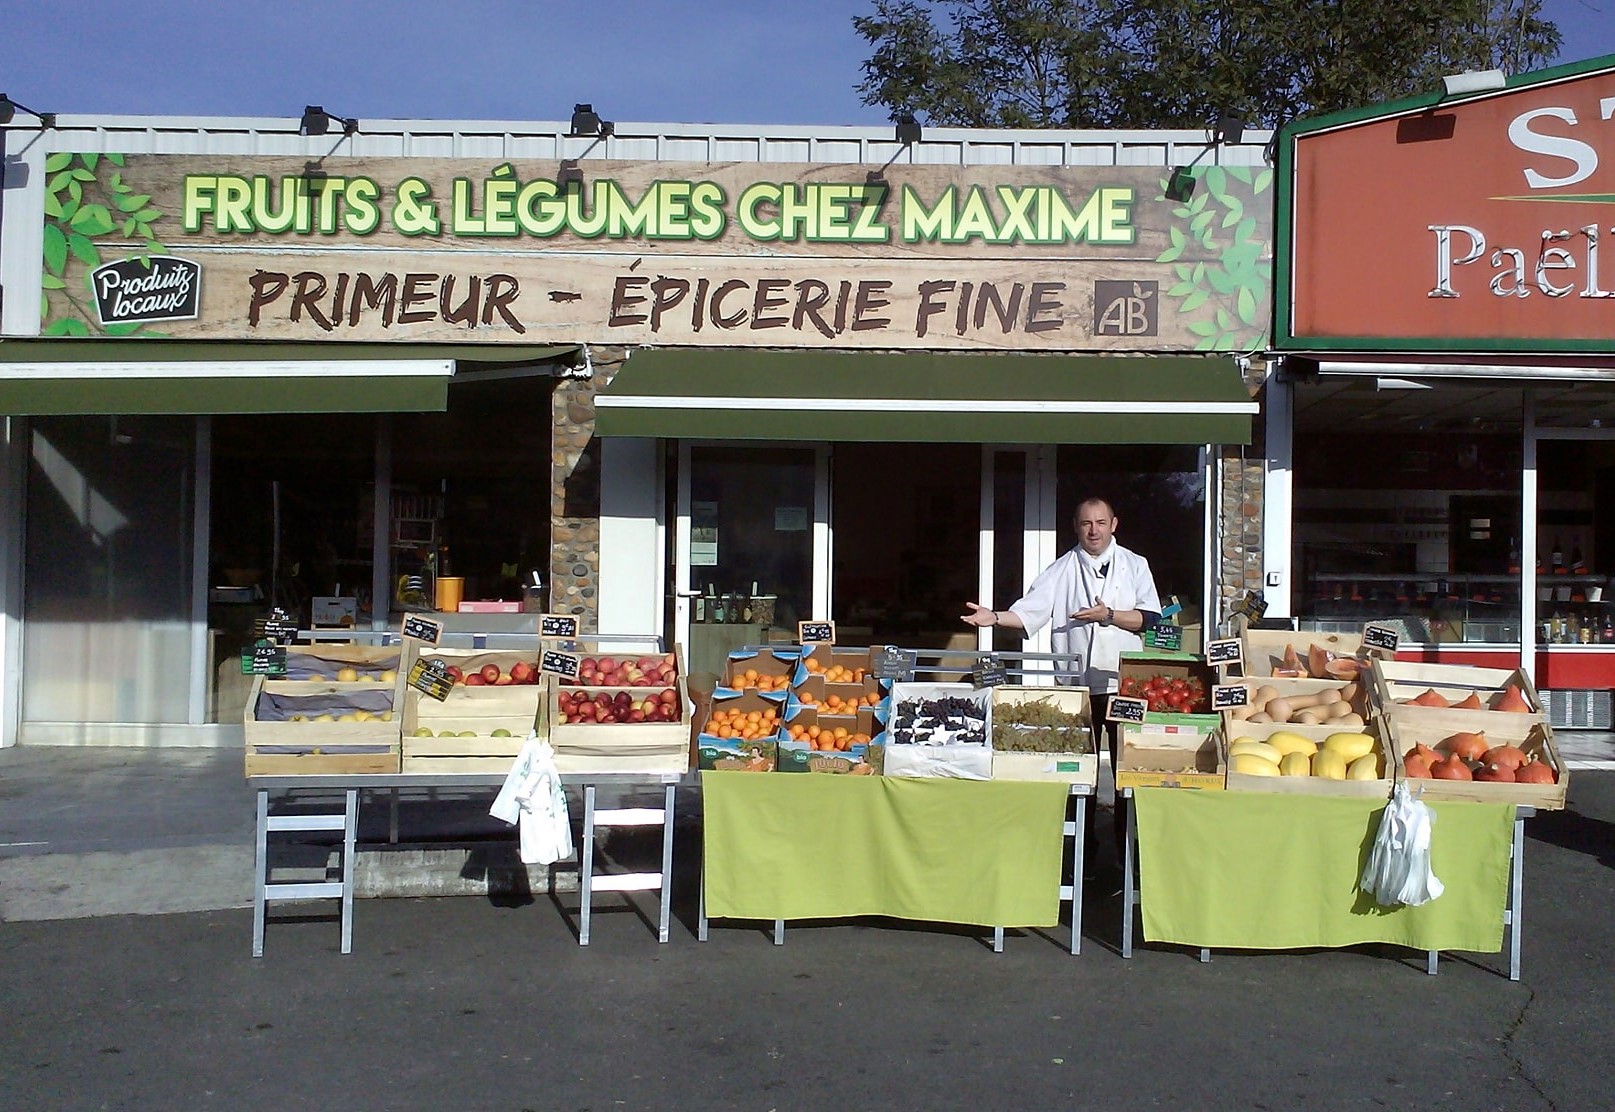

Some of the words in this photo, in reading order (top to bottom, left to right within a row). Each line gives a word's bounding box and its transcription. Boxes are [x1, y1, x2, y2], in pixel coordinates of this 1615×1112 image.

[183, 174, 379, 235] FRUITS
[391, 177, 441, 236] &
[451, 164, 727, 240] LÉGUMES
[737, 182, 889, 243] CHEZ
[903, 183, 1135, 246] MAXIME
[98, 264, 195, 299] Produits
[1428, 223, 1615, 298] Paël
[113, 291, 187, 317] locaux
[249, 268, 525, 334] PRIMEUR
[608, 257, 894, 338] ÉPICERIE
[915, 279, 1066, 337] FINE
[1098, 294, 1149, 335] AB
